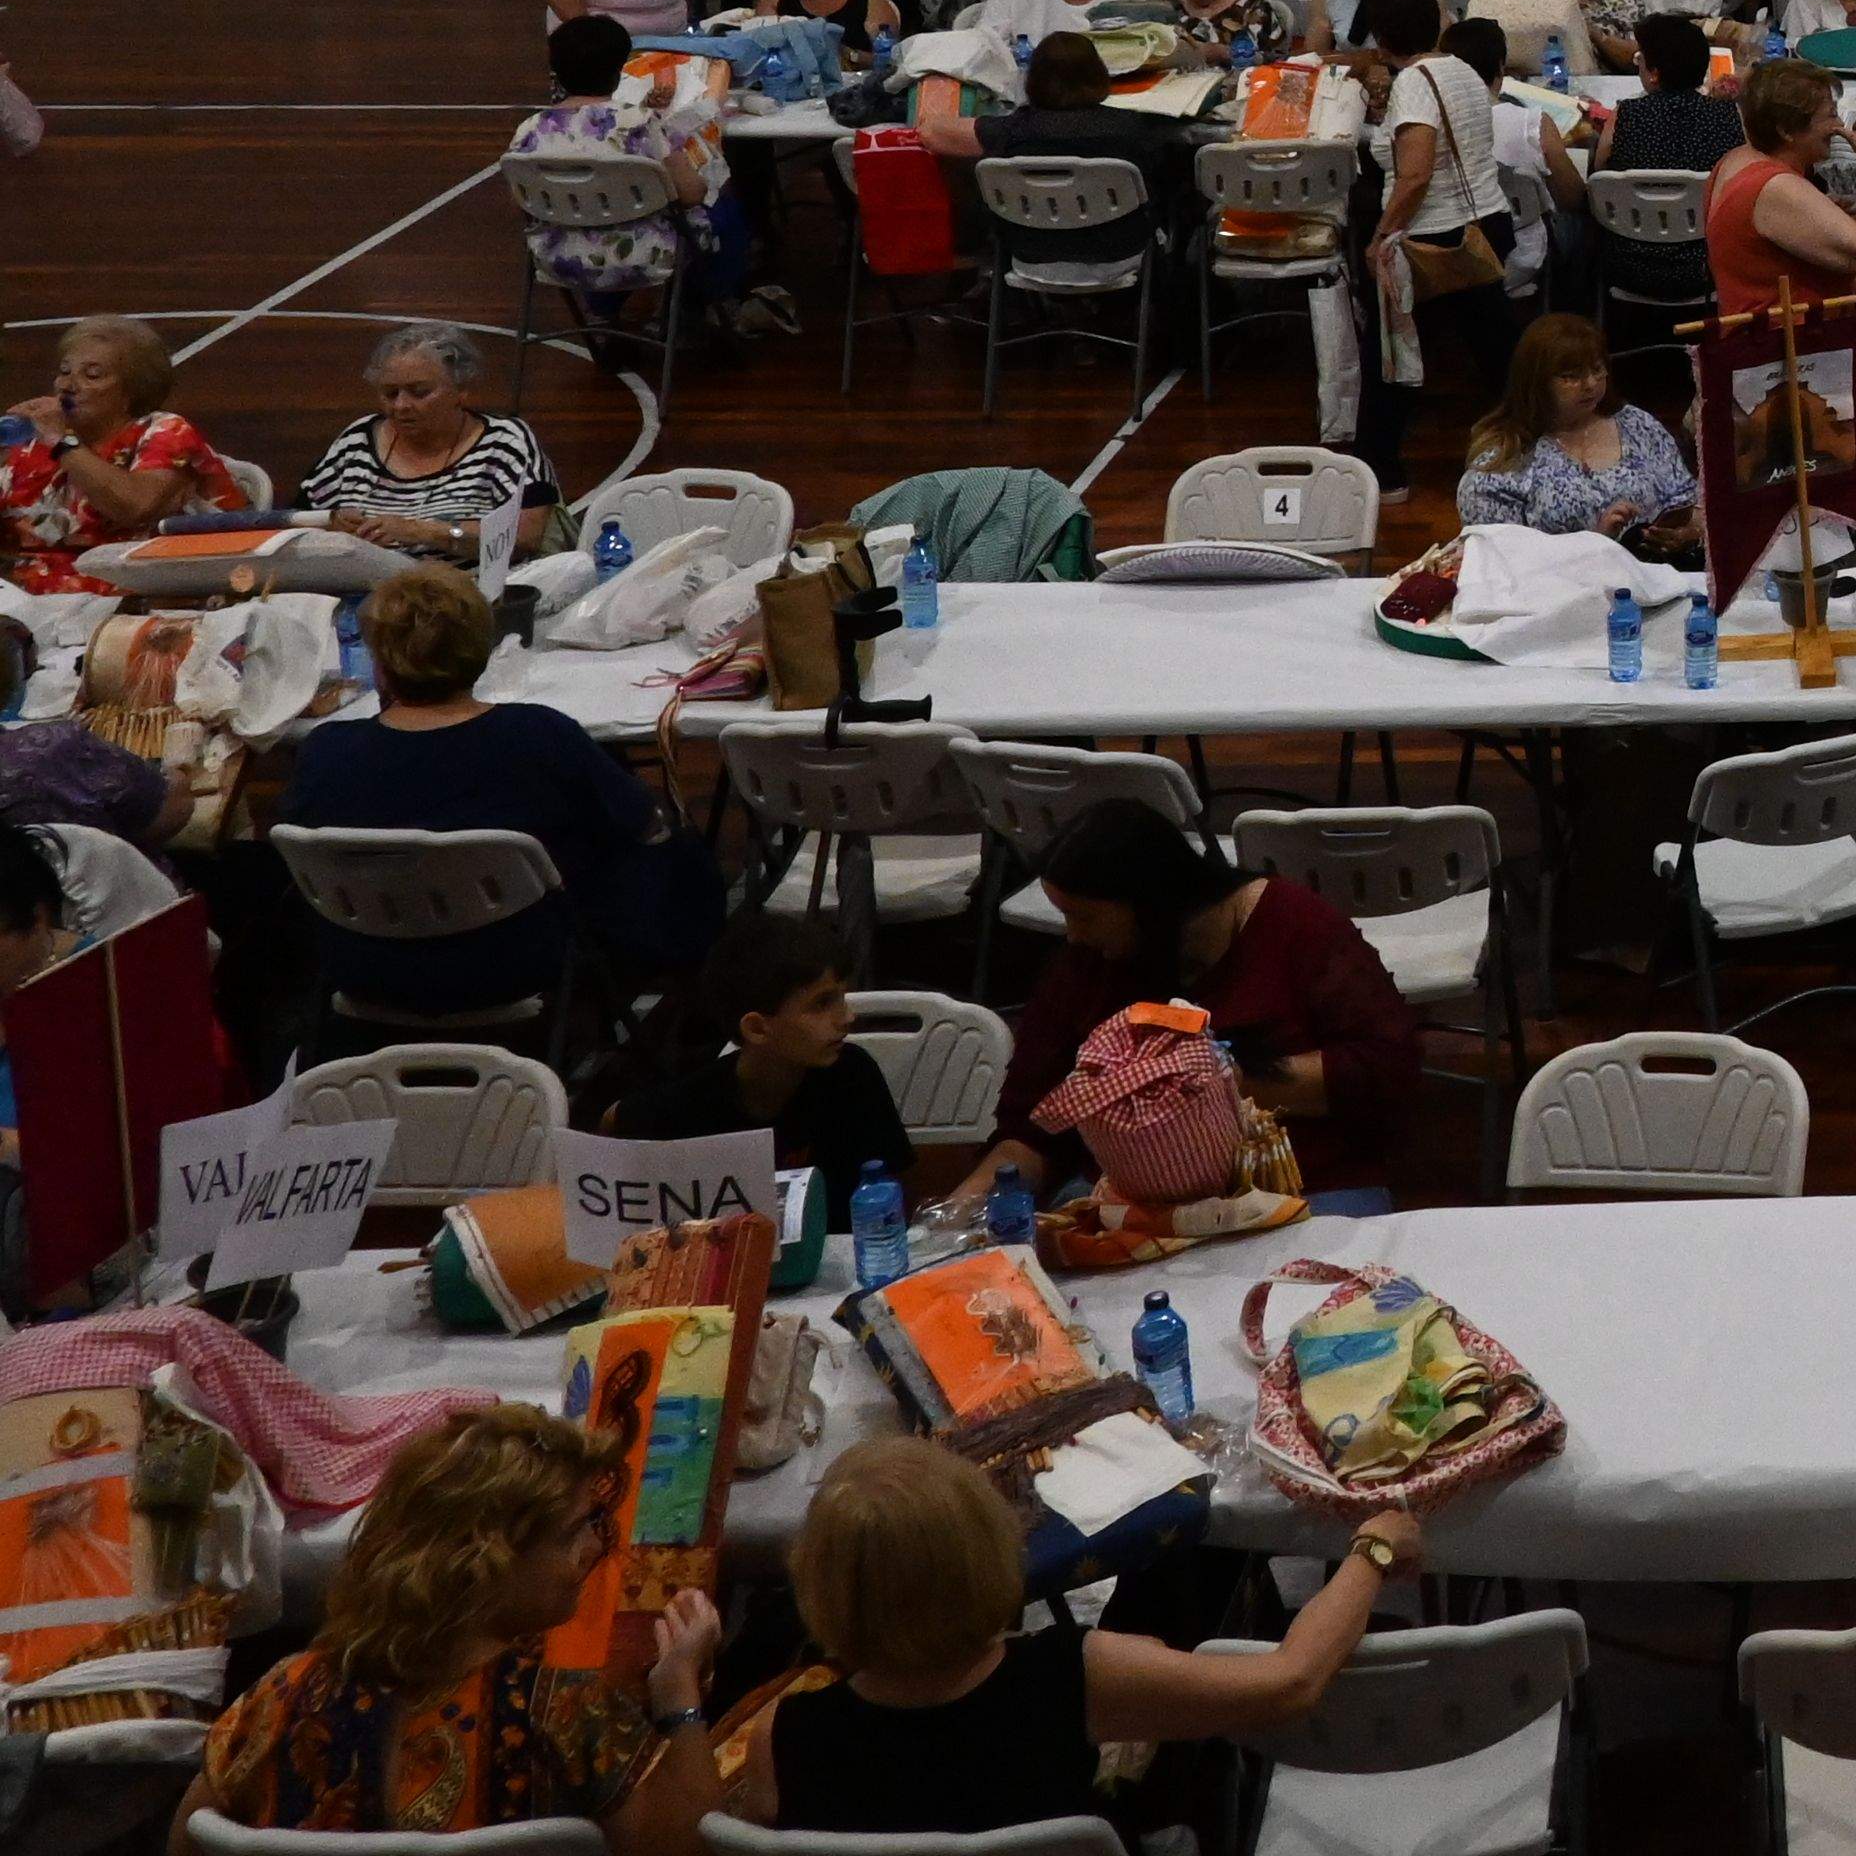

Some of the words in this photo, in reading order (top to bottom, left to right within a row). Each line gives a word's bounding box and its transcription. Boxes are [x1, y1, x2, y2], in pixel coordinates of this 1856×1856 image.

[1275, 494, 1289, 516] 4
[235, 1158, 373, 1225] VALFARTA
[578, 1173, 754, 1224] SENA
